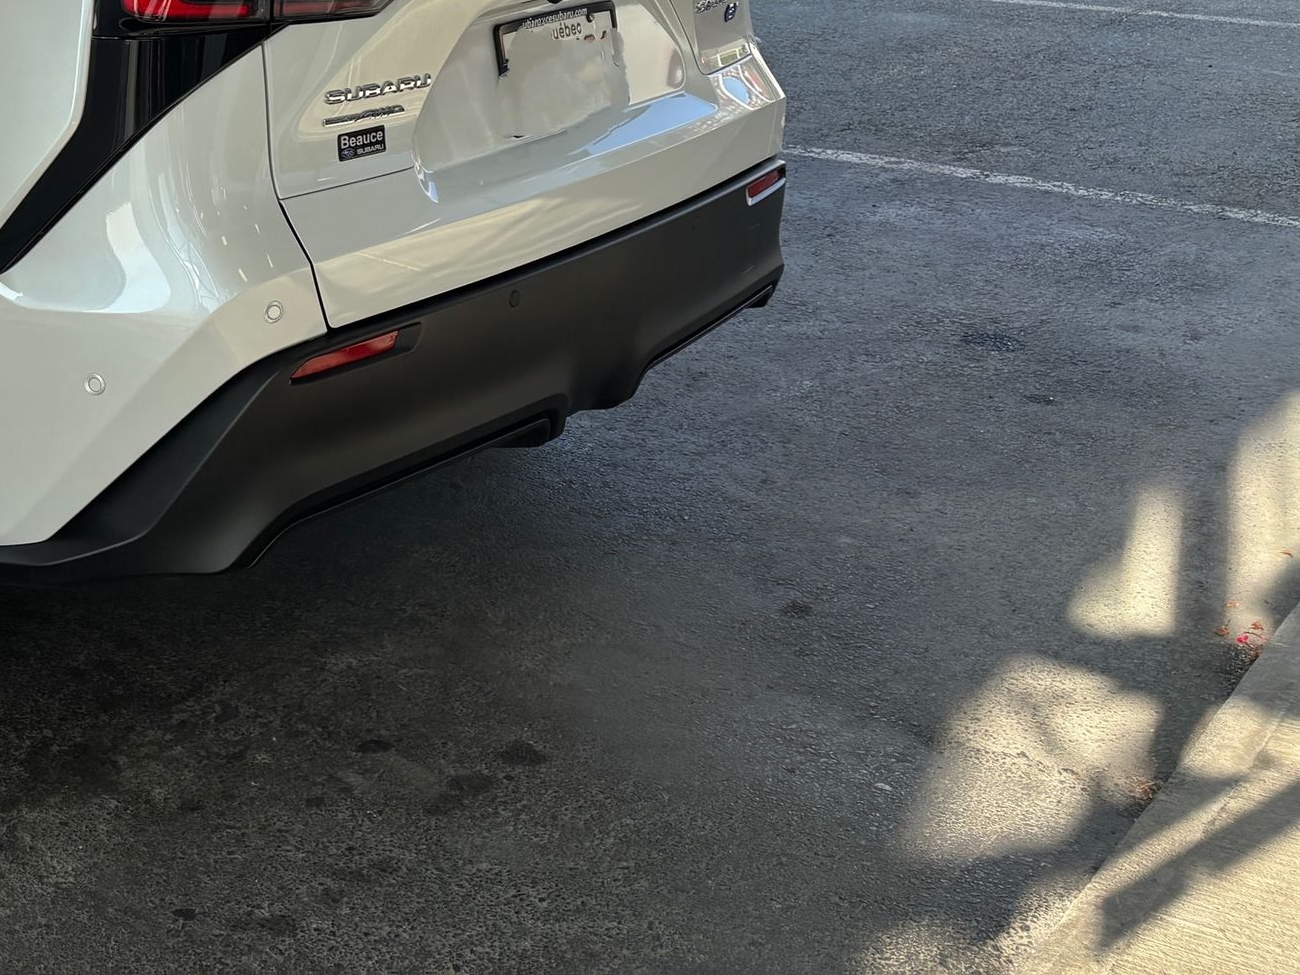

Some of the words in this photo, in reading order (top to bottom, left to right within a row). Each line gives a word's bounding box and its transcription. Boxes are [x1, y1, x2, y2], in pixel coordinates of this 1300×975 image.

[552, 22, 582, 40] uébec
[324, 73, 432, 104] SUBARU
[340, 130, 384, 149] Beauce
[356, 143, 385, 155] SUBARU
